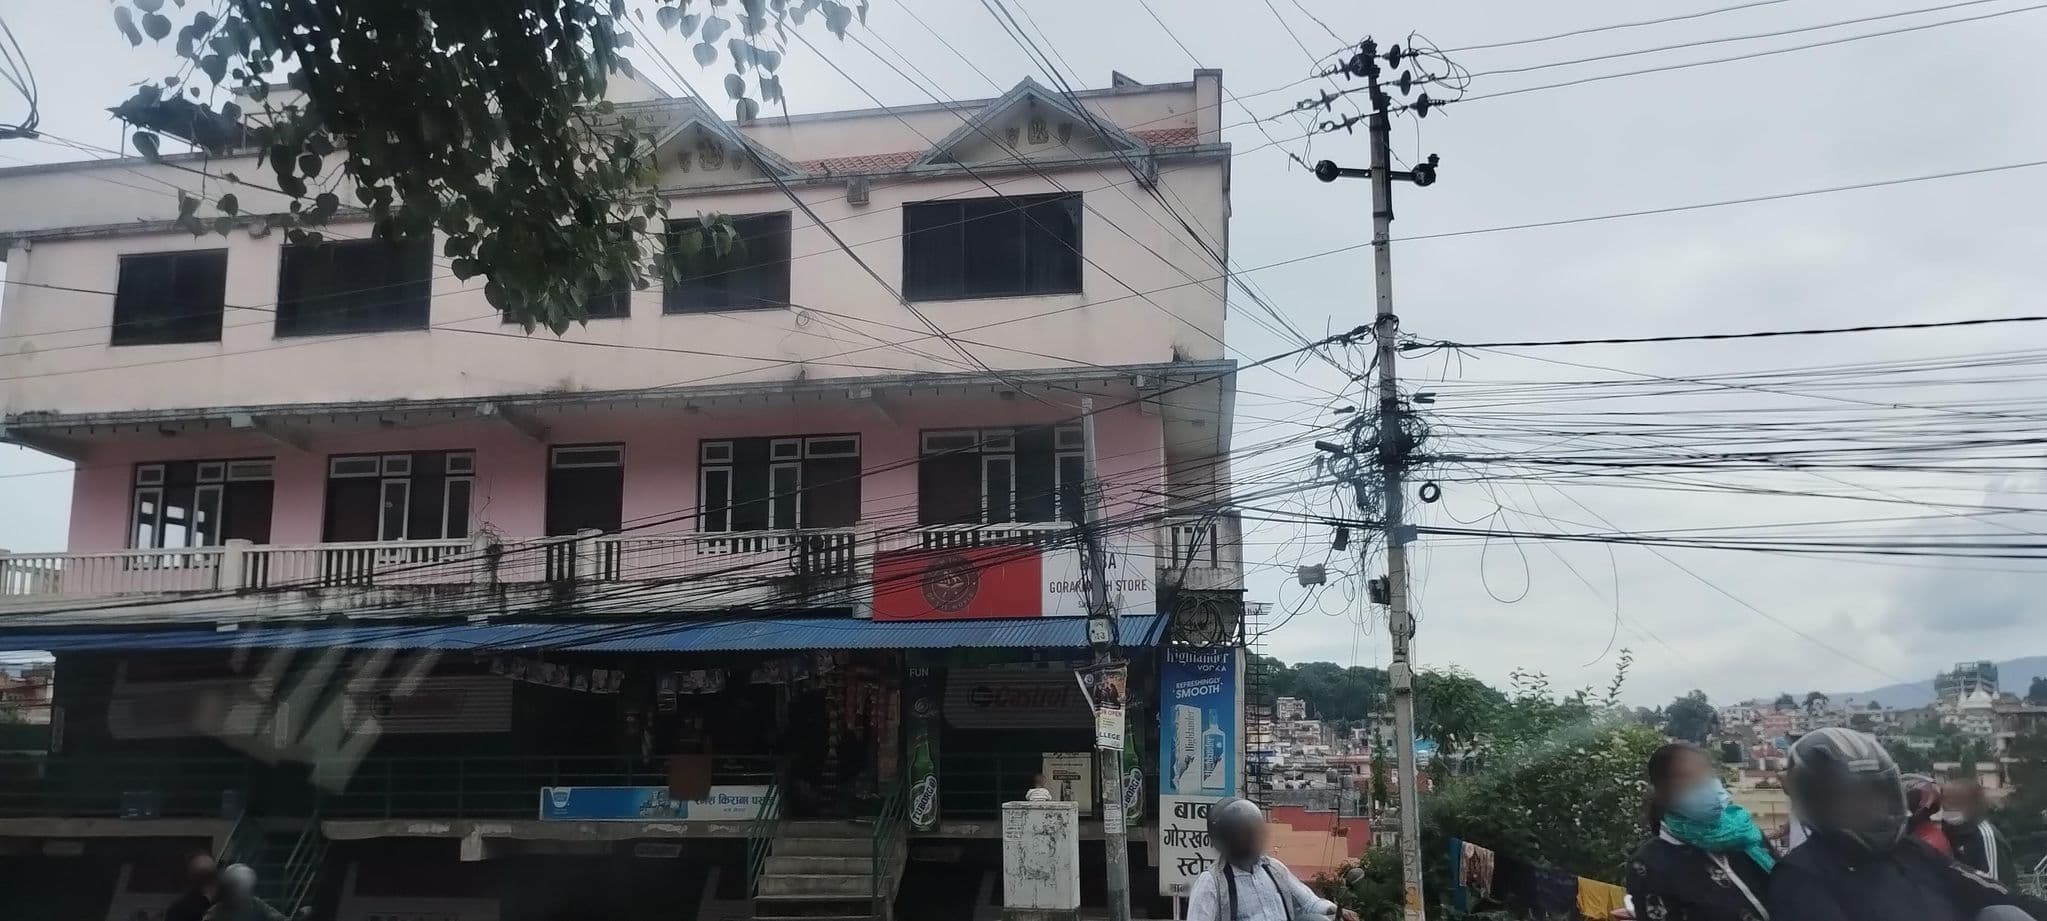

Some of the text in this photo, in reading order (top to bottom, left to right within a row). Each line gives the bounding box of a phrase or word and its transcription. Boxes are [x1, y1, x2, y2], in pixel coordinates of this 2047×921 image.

[1116, 579, 1148, 592] STORE
[909, 667, 929, 677] FUN
[1175, 677, 1221, 689] REFRESHINGLY
[1174, 801, 1216, 819] बाब
[1176, 852, 1215, 877] स्टो
